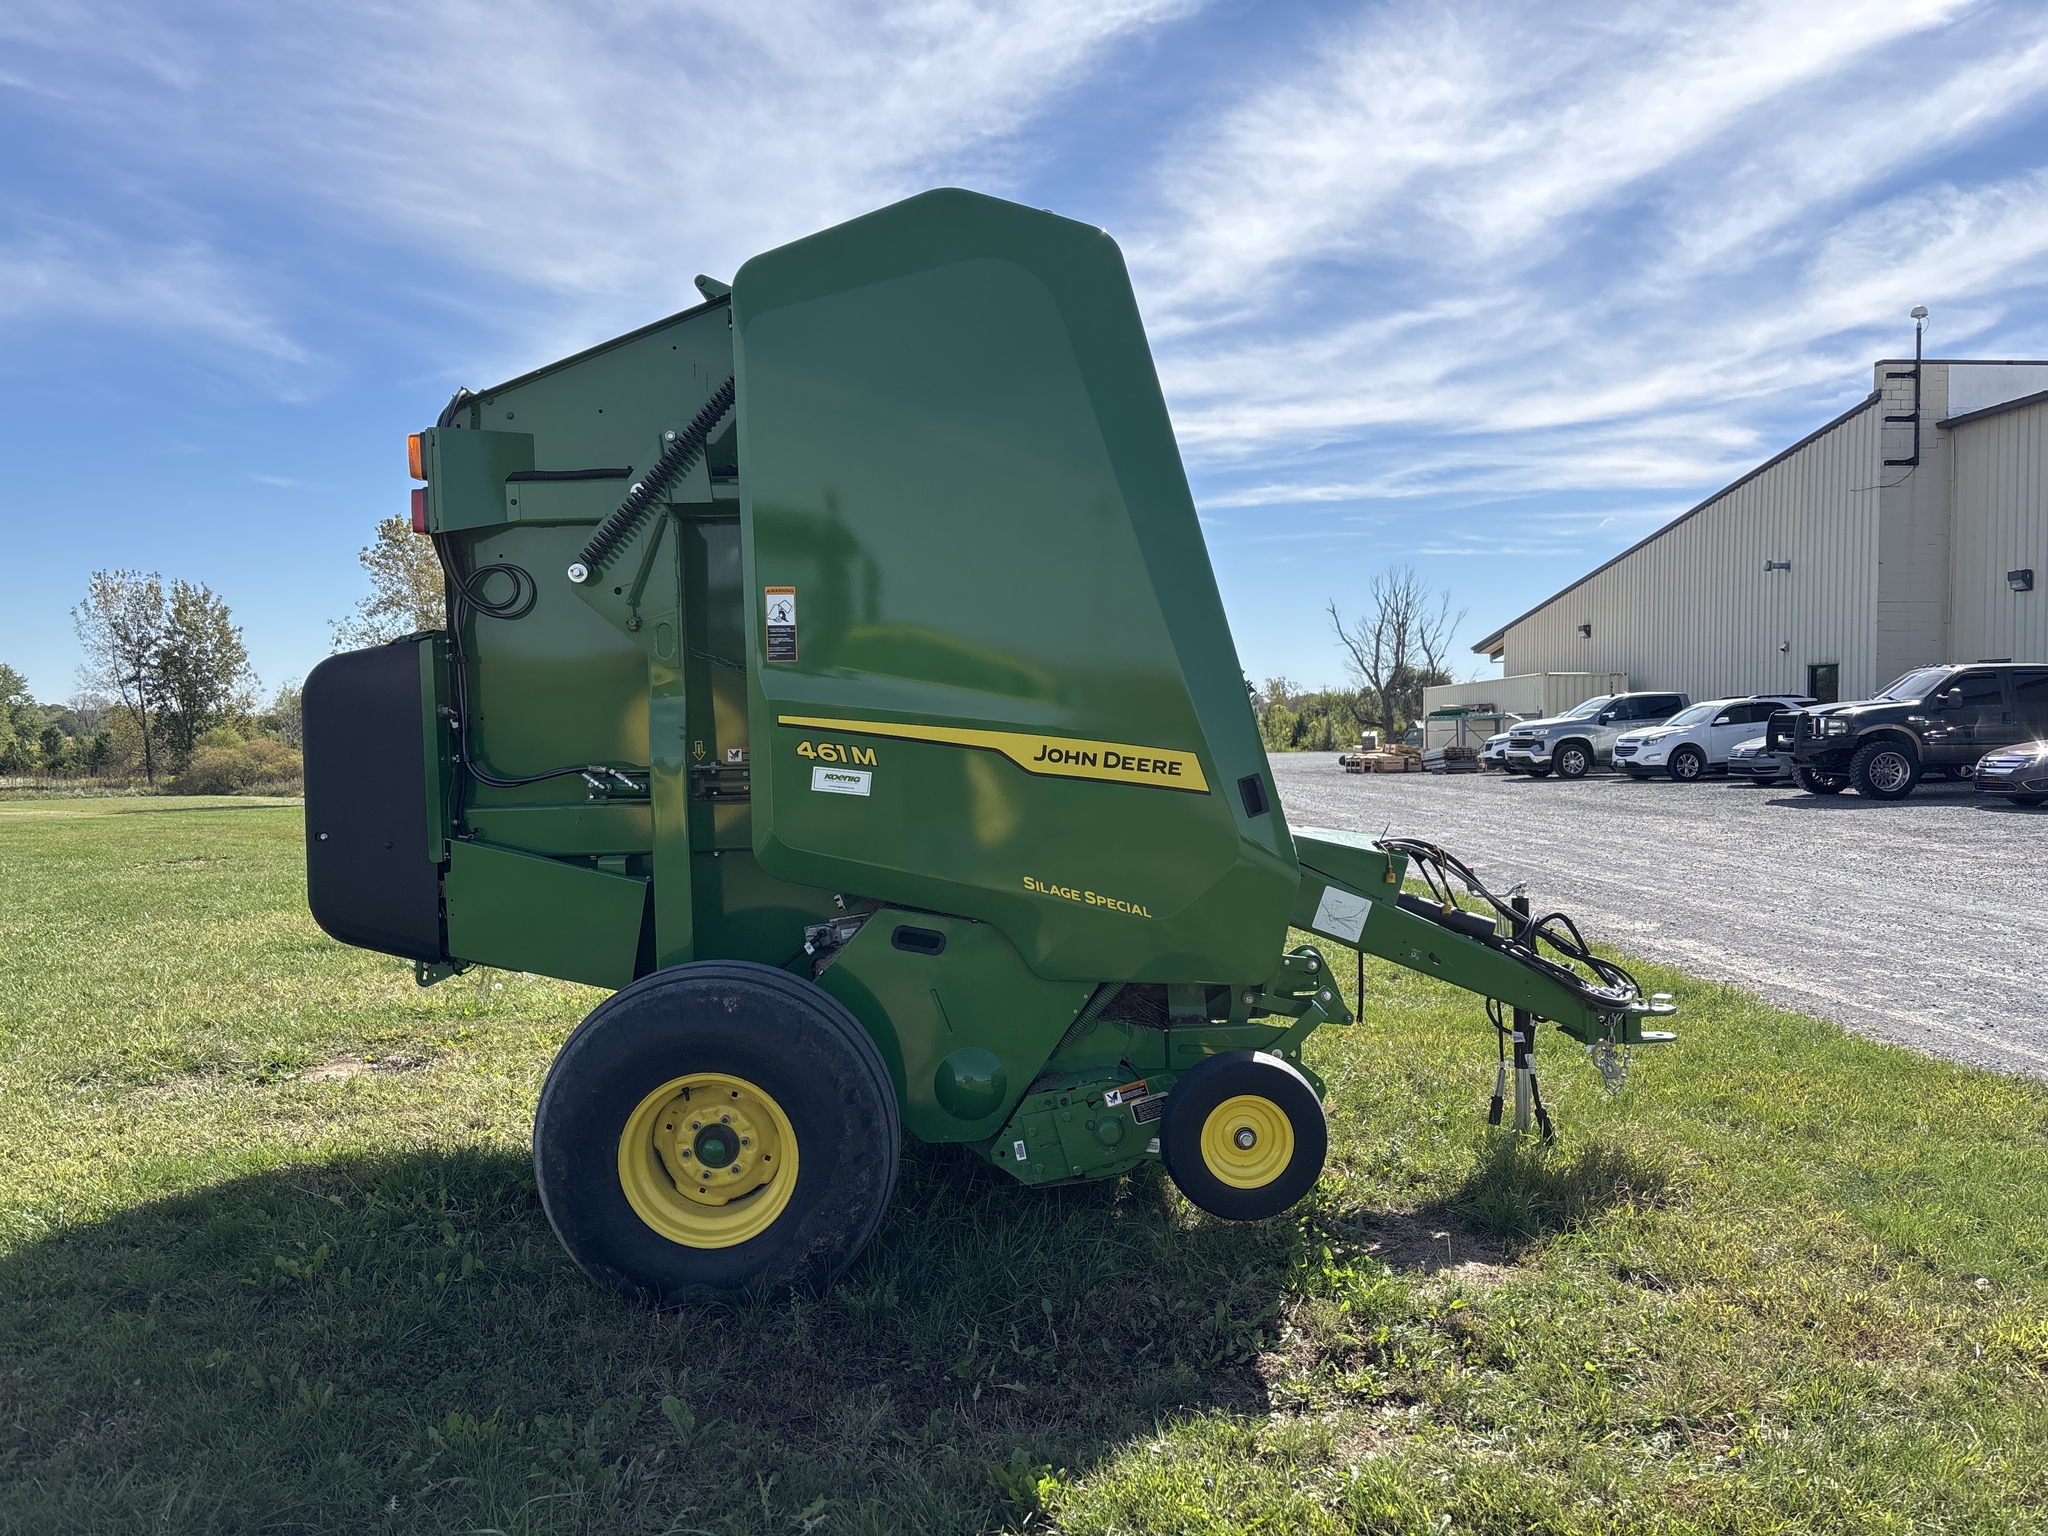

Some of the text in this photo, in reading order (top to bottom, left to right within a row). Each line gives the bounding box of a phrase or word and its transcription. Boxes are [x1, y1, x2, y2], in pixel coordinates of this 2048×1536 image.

[1033, 745, 1183, 776] JOHN DEERE
[1023, 876, 1152, 918] SILAGE SPECIAL
